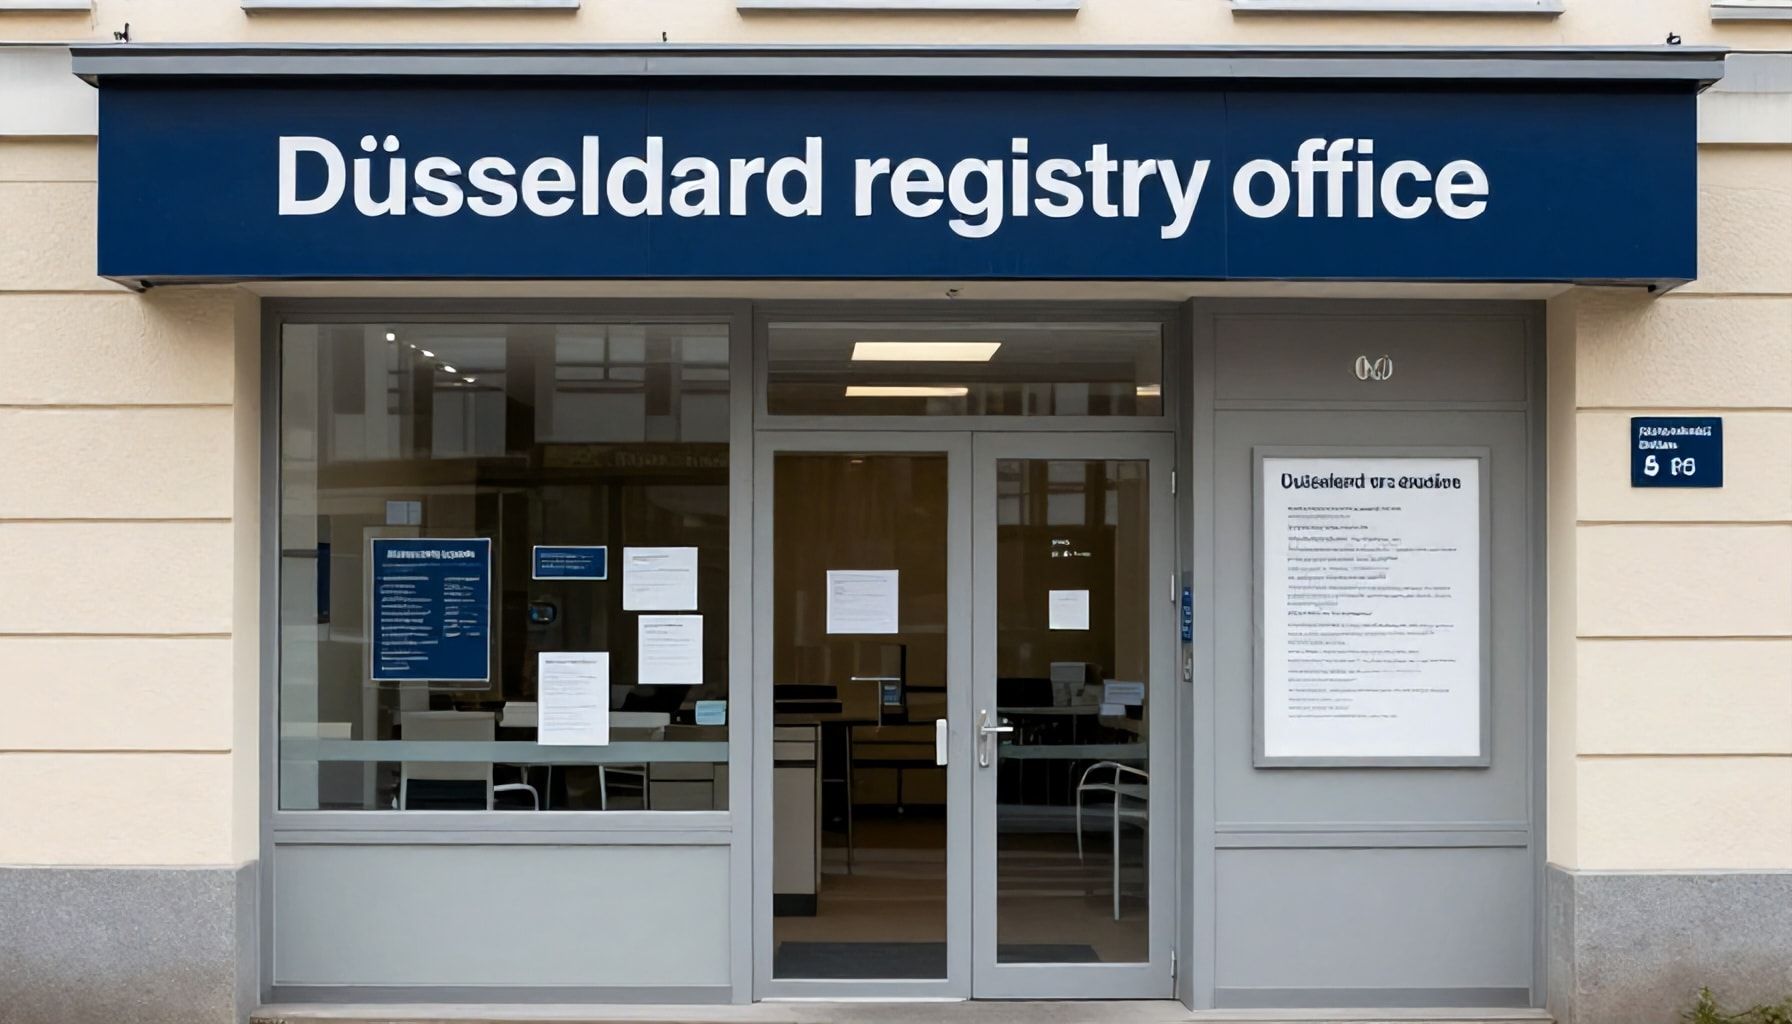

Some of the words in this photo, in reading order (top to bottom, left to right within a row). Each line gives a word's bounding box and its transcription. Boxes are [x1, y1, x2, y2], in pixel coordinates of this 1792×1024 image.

[278, 135, 823, 218] Düsseldard
[855, 138, 1211, 240] registry
[1233, 137, 1489, 220] office
